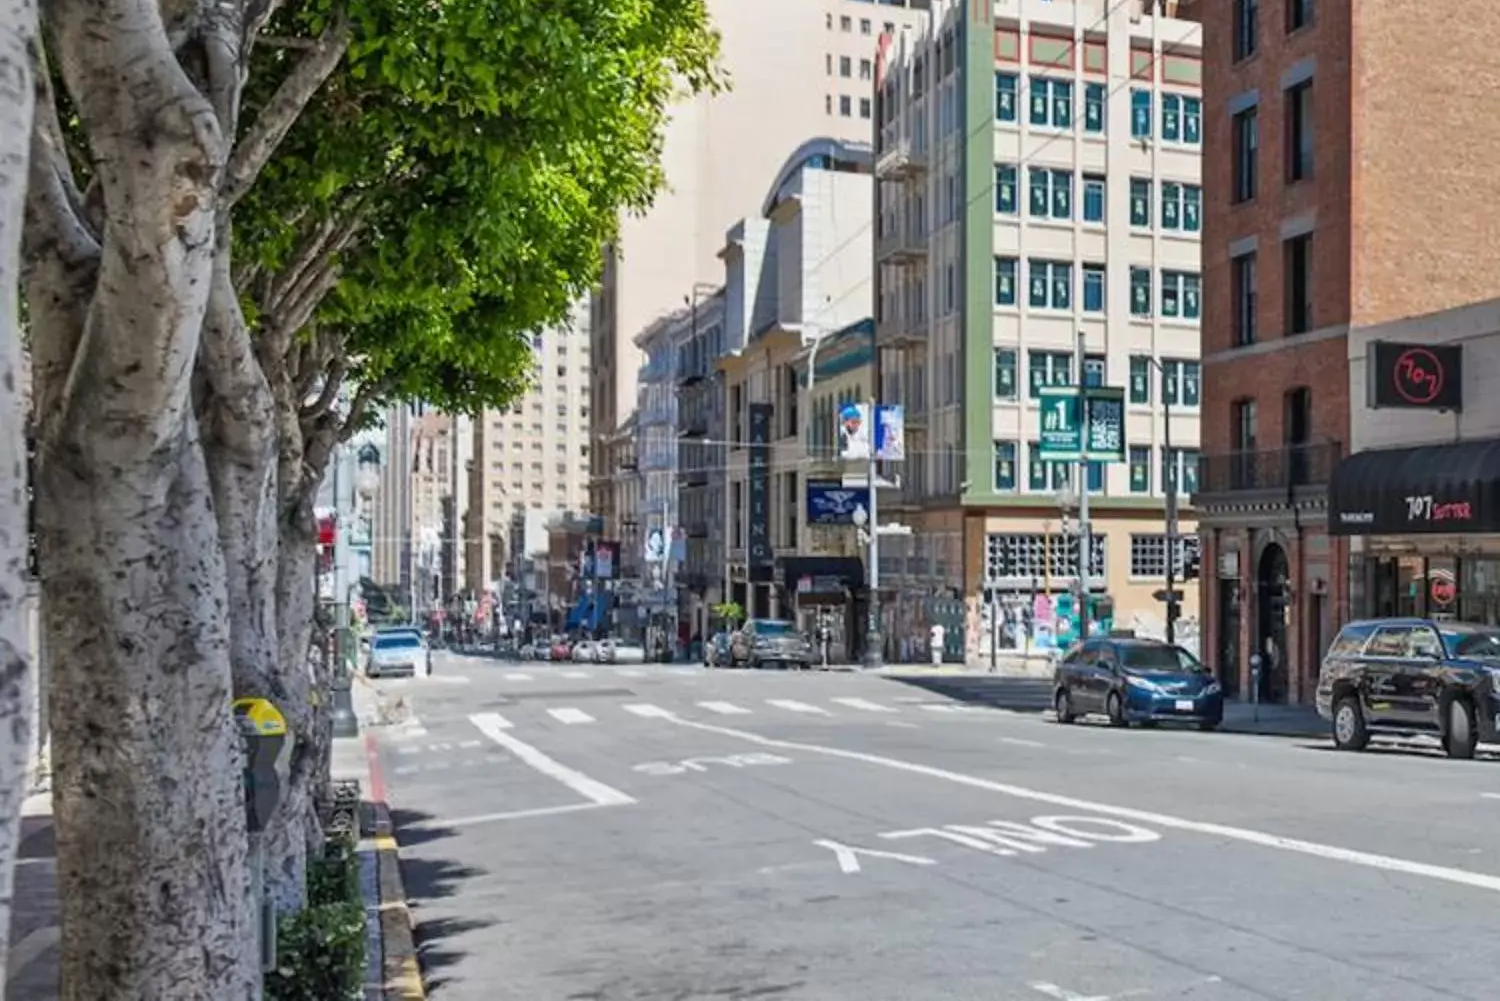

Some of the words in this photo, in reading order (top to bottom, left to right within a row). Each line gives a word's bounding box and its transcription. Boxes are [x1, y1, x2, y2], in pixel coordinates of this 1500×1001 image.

[1401, 358, 1437, 396] 707
[752, 408, 766, 557] PARKING
[1405, 495, 1433, 520] 707
[812, 814, 1163, 874] ONLY
